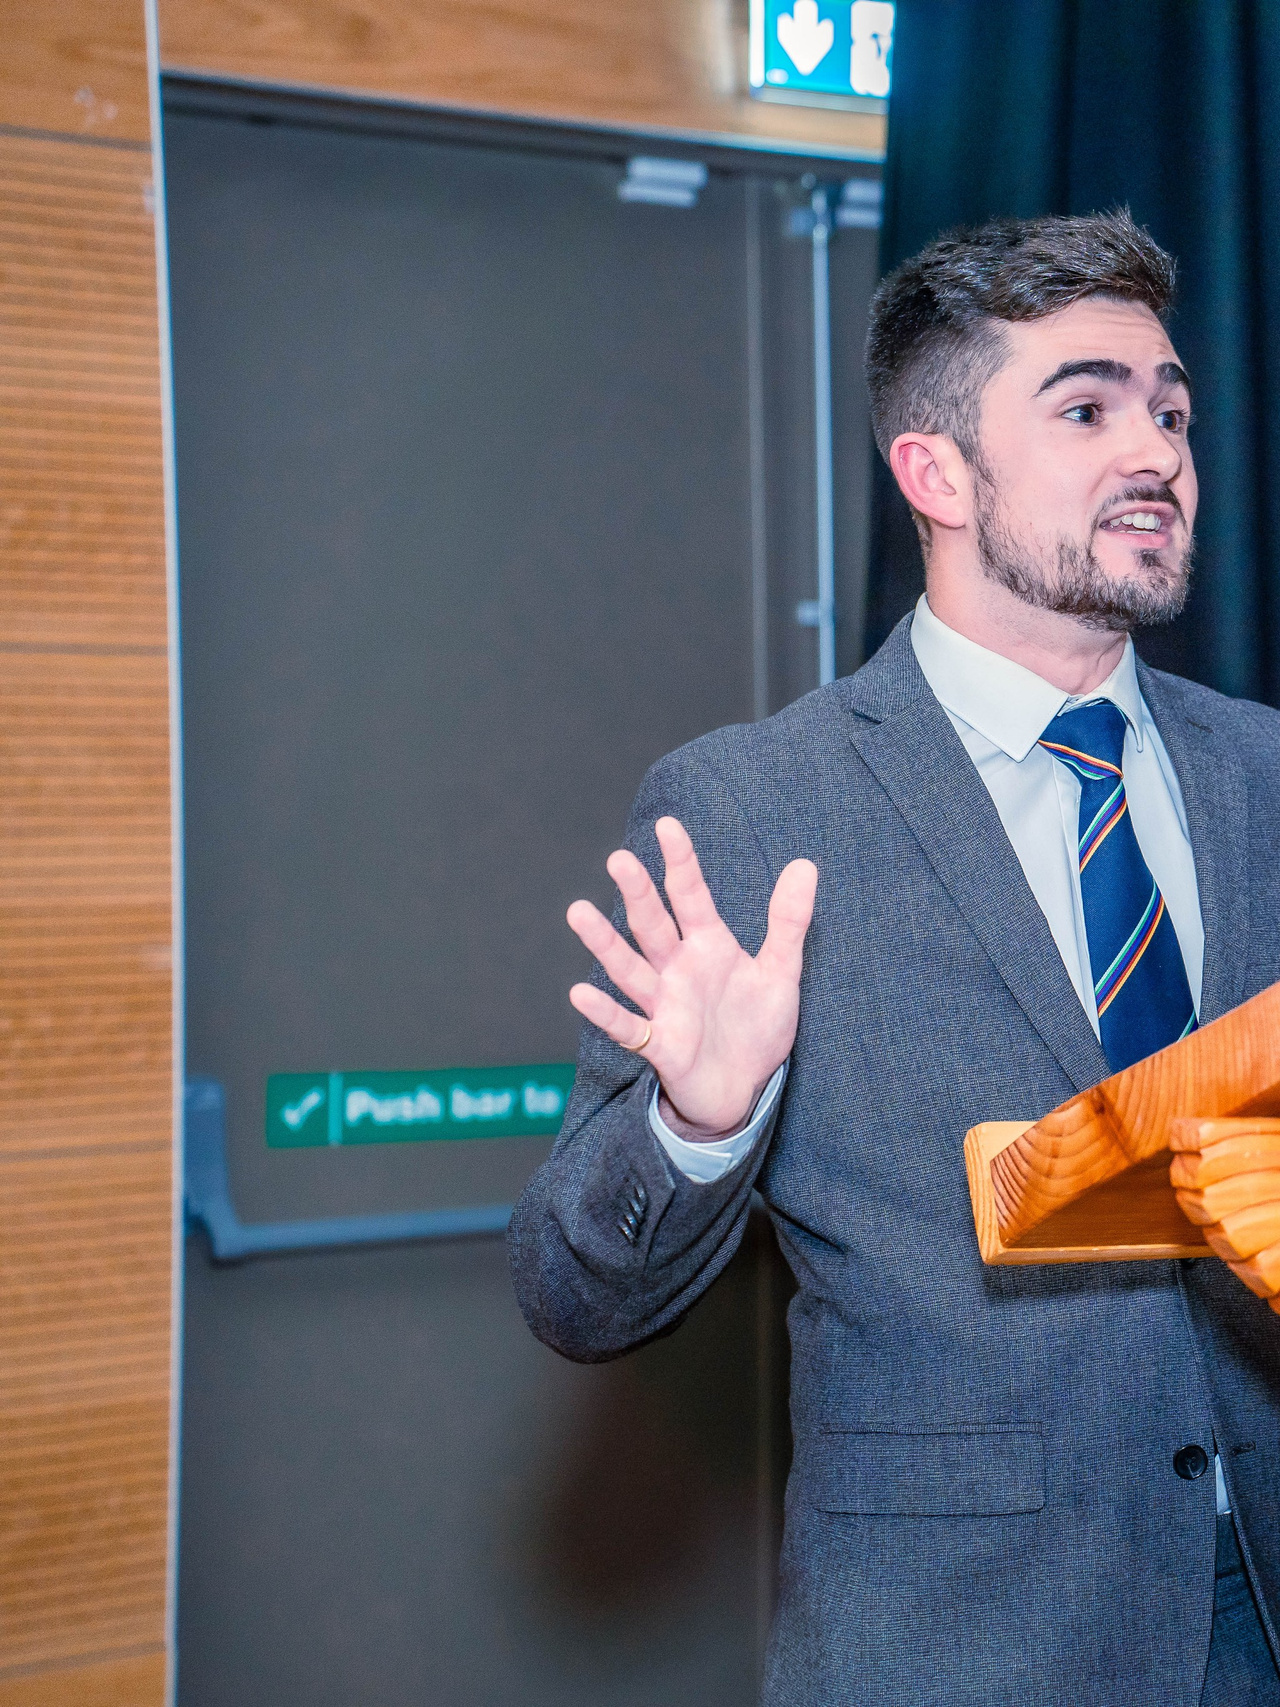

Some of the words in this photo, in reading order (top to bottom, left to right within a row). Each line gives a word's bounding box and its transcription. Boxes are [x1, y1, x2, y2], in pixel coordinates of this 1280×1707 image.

[346, 1086, 442, 1124] Push
[451, 1086, 513, 1119] bar
[523, 1084, 562, 1116] to
